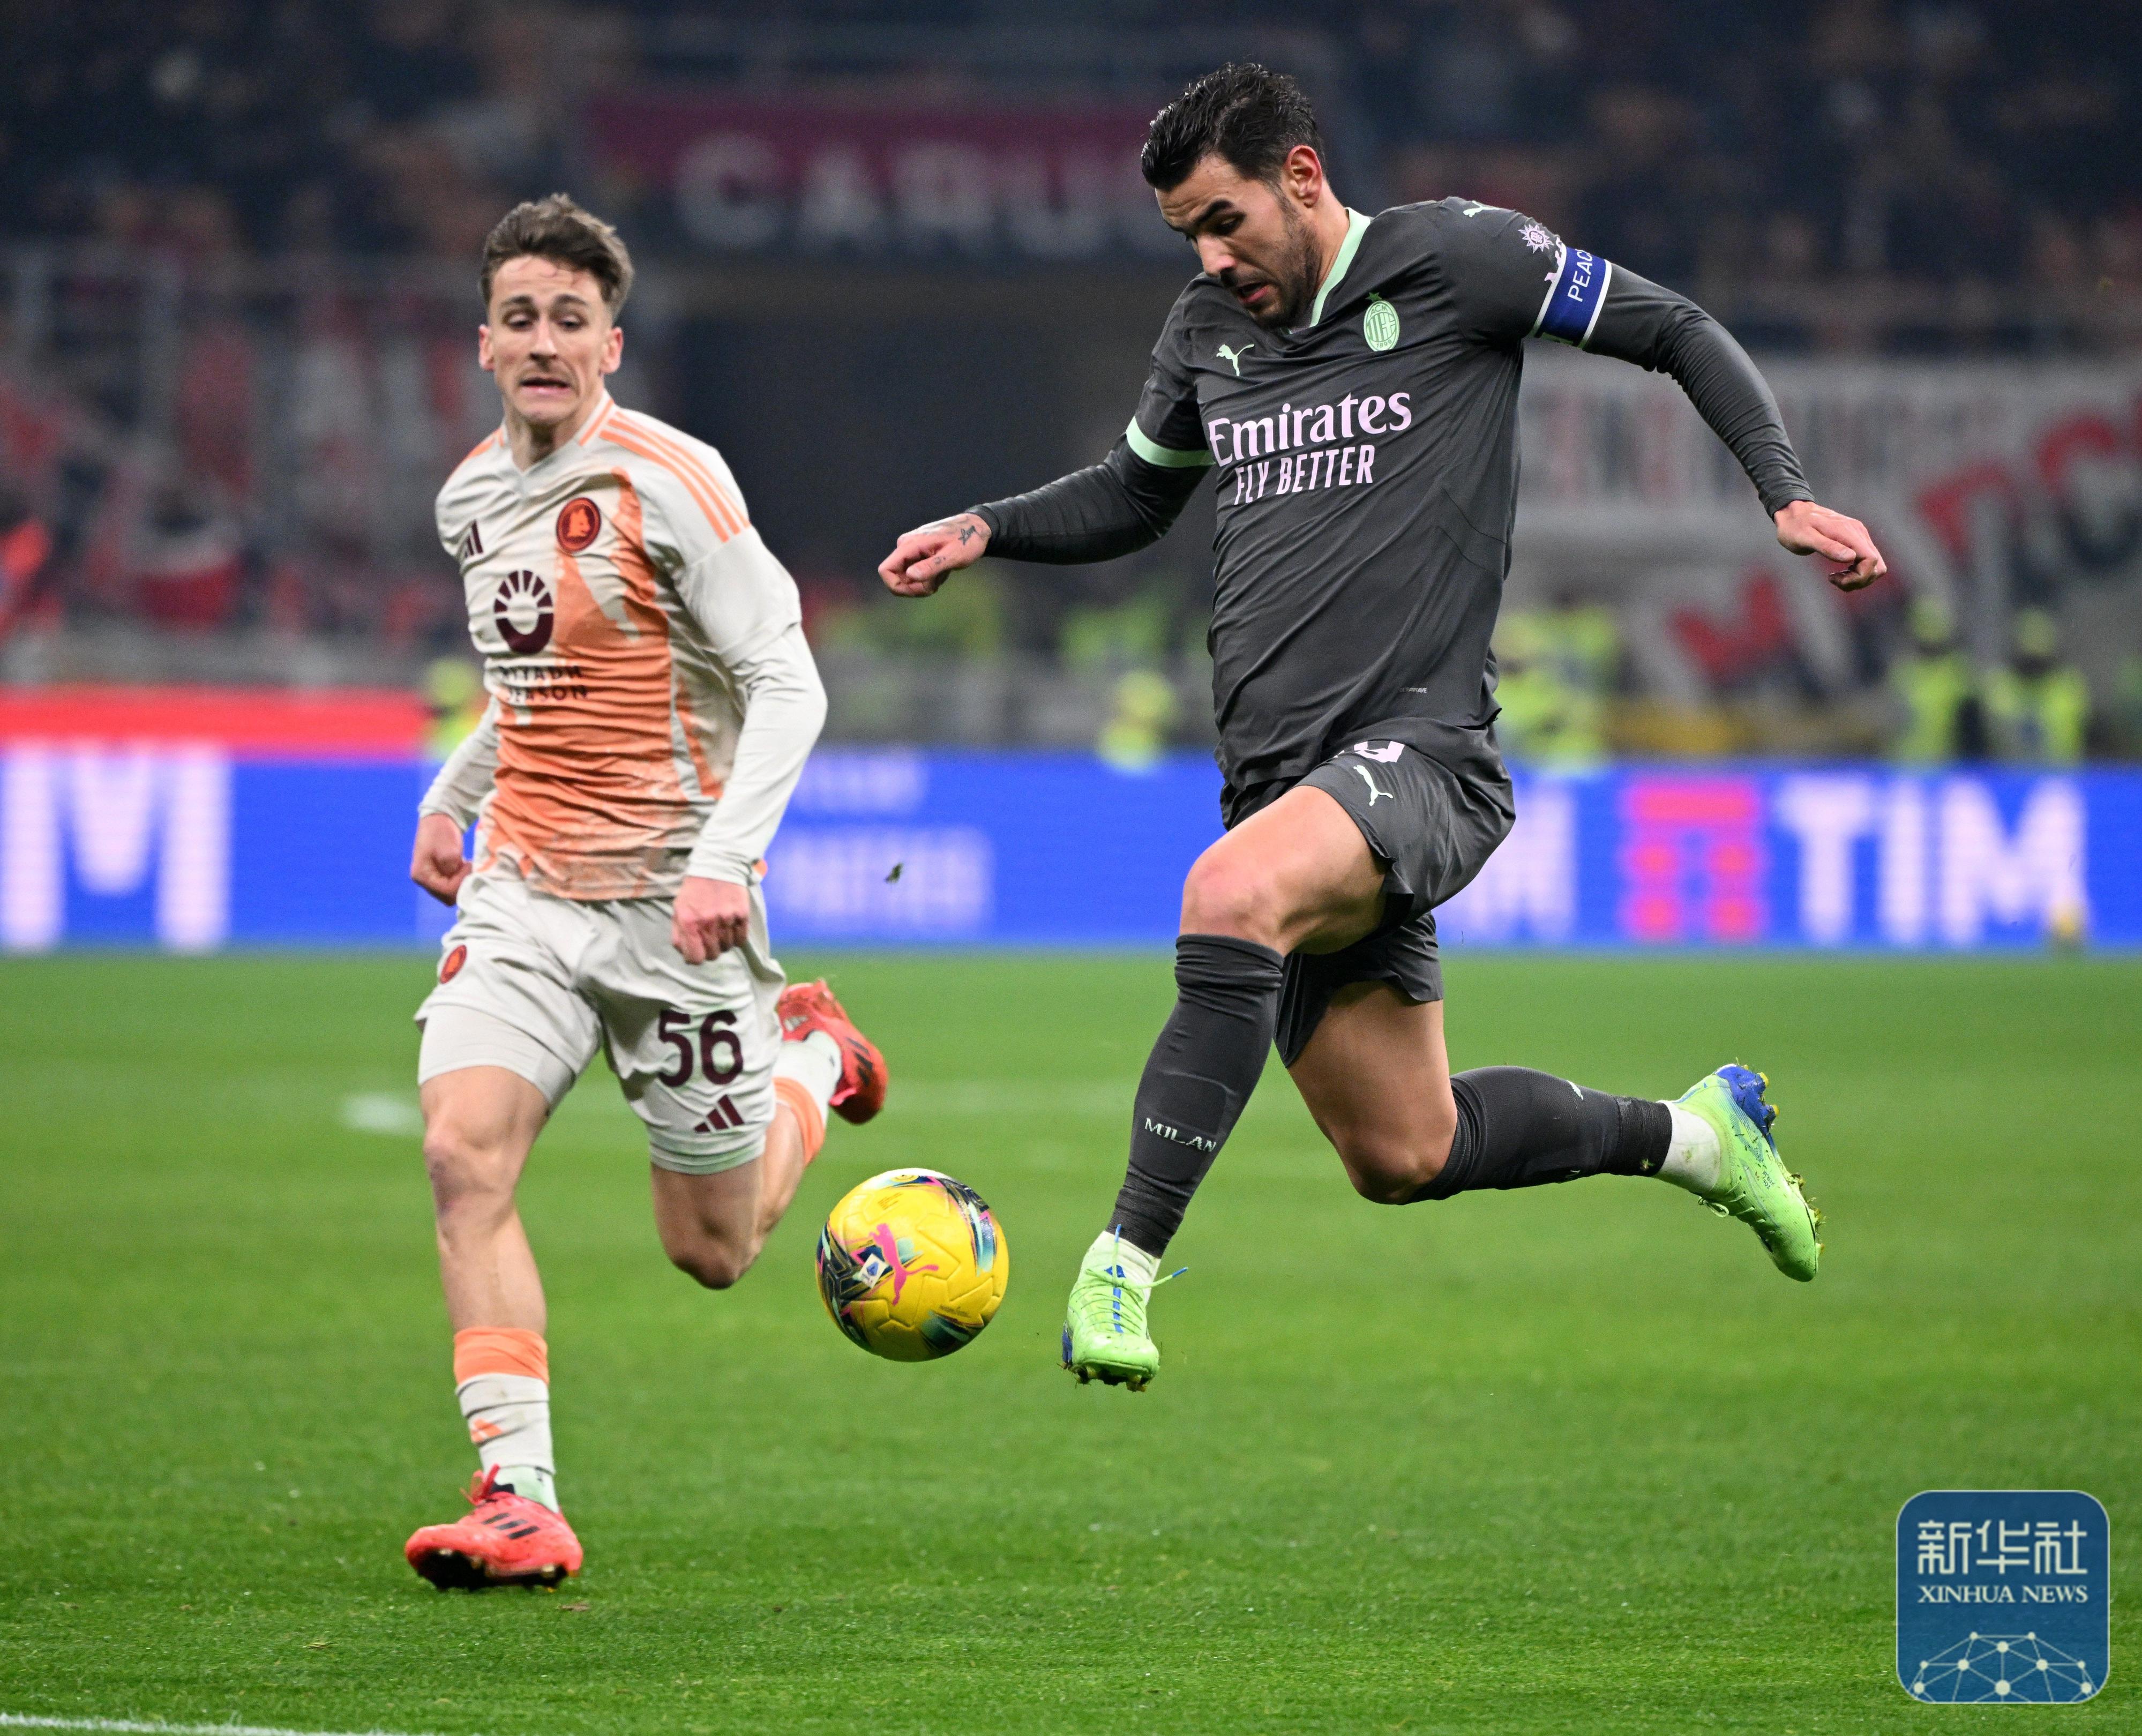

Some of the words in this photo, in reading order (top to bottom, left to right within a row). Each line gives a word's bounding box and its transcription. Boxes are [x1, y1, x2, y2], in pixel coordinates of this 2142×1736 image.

[1567, 249, 1593, 302] PEAC
[1370, 304, 1388, 316] ACM
[1377, 339, 1392, 348] 1899
[1208, 392, 1412, 467] Emirates
[1234, 461, 1269, 505] FLY
[1276, 445, 1375, 495] BETTER
[1774, 772, 2087, 947] TIM
[658, 1009, 744, 1087] 56
[1144, 1118, 1216, 1152] MILAN
